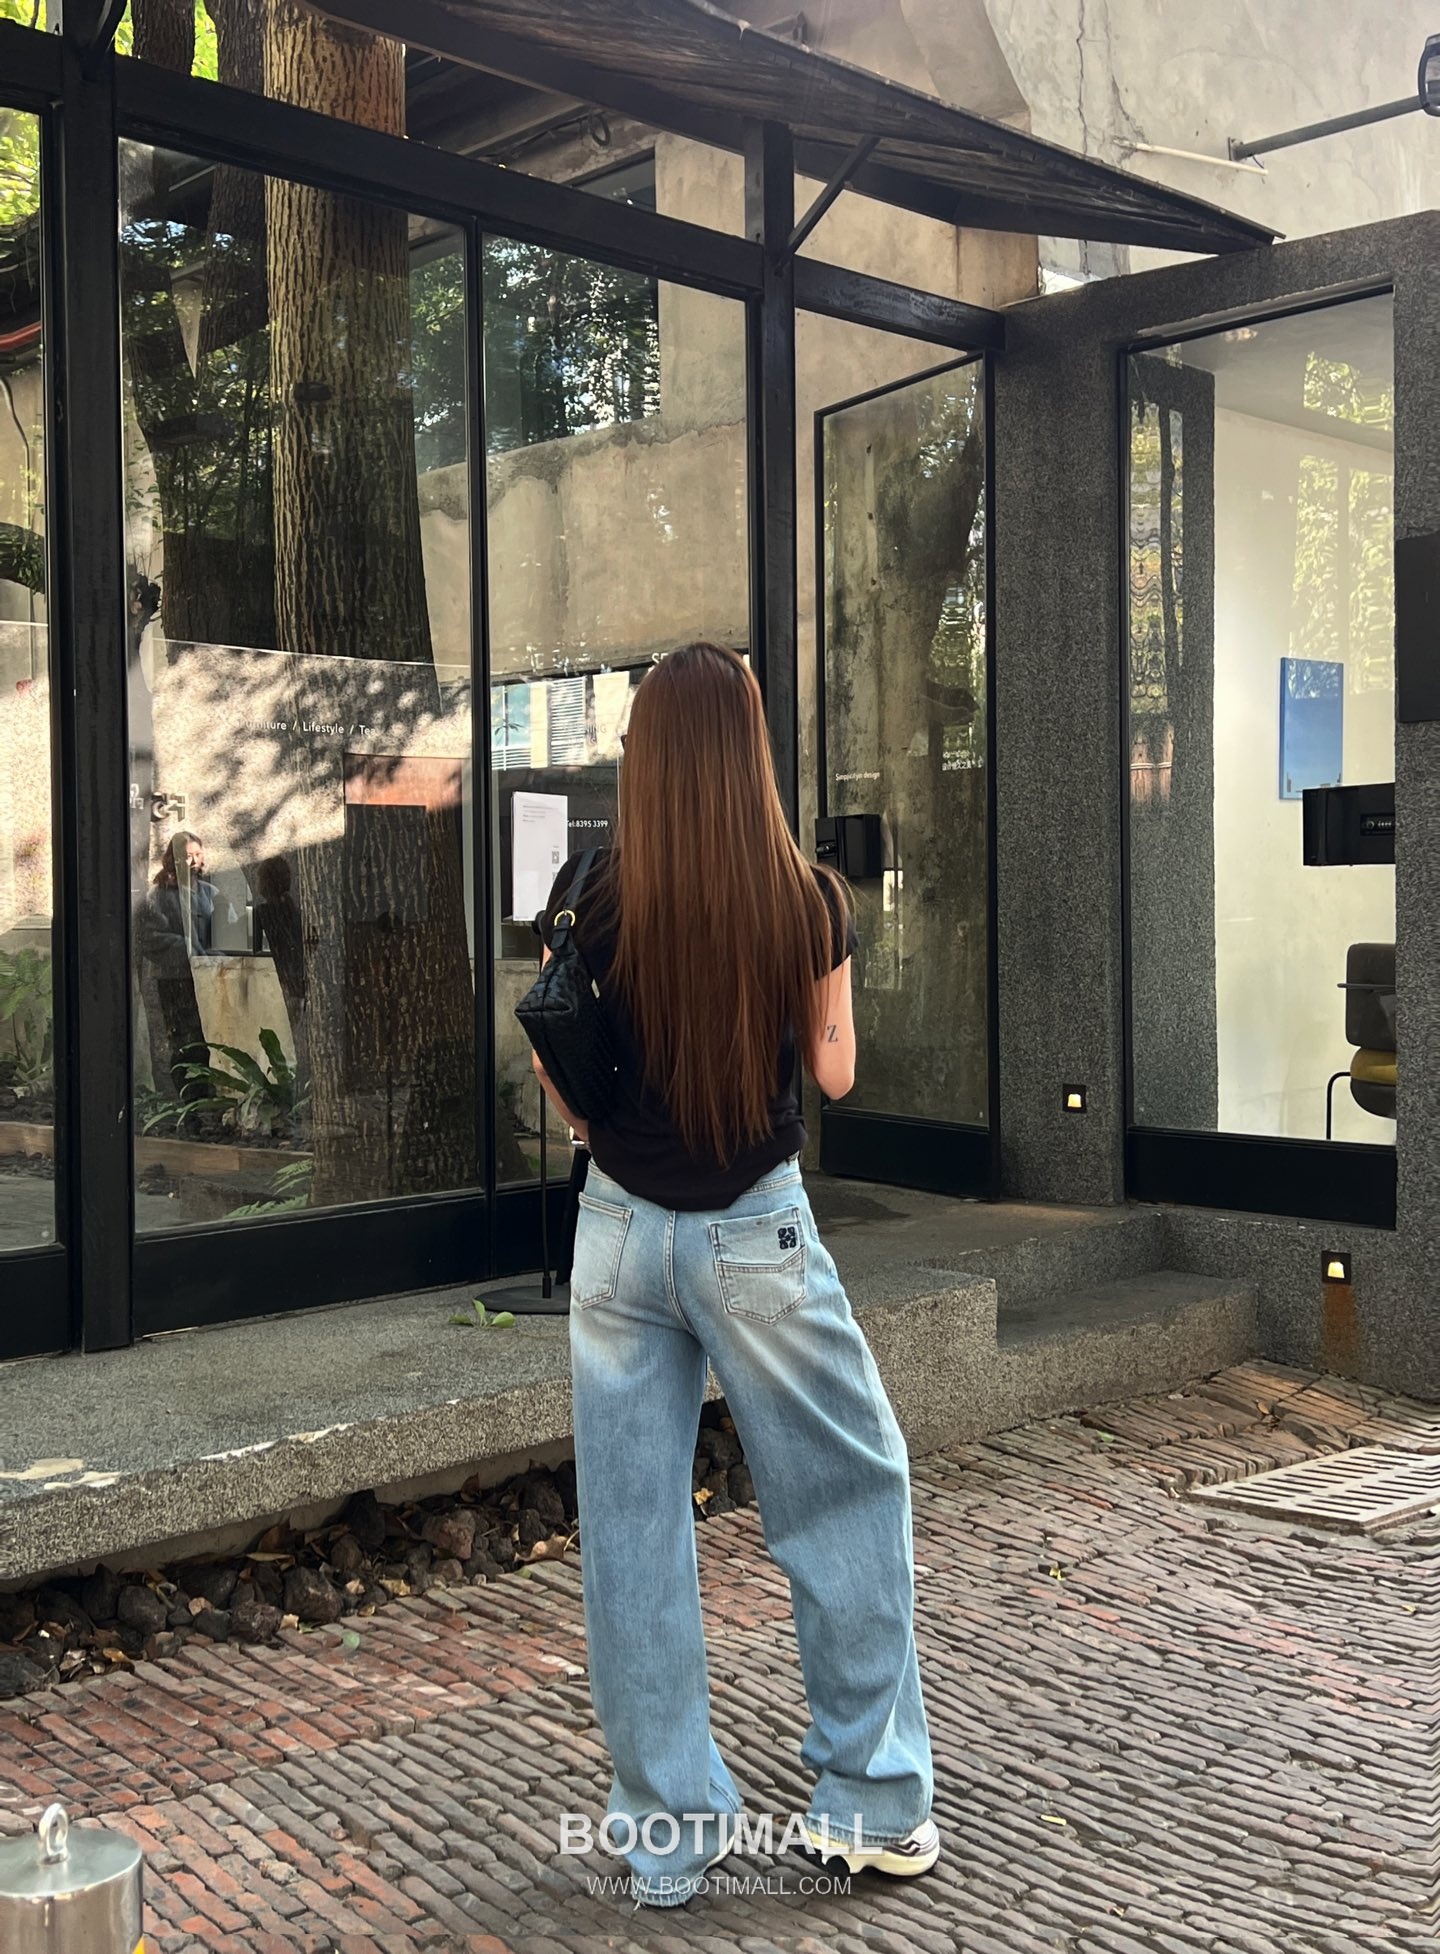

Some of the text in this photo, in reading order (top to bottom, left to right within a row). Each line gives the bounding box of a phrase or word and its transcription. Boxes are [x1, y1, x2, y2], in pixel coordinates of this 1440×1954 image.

[303, 721, 344, 735] Lifestyle
[359, 725, 376, 736] Tea
[827, 1024, 839, 1043] Z
